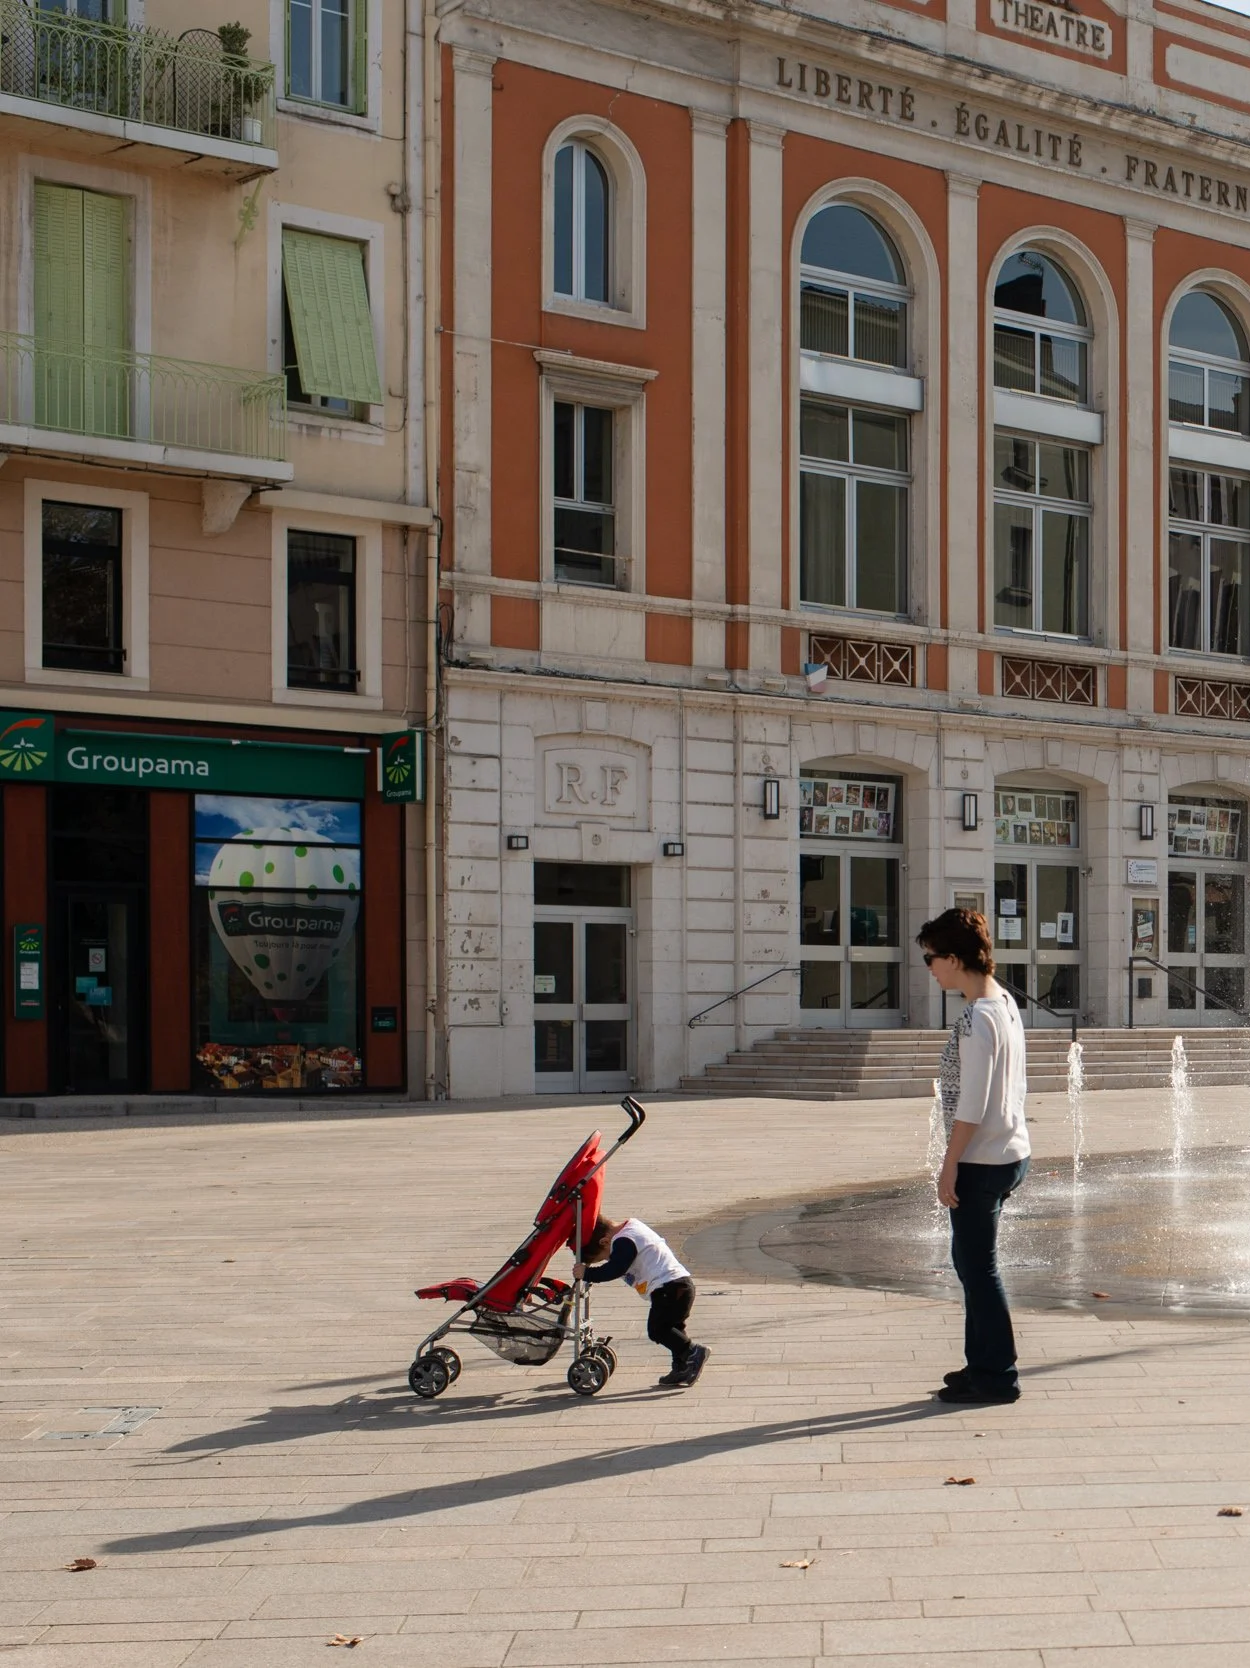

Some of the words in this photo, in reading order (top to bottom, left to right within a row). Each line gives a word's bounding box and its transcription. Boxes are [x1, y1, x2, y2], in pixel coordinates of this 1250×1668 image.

[998, 0, 1105, 52] THEATRE
[777, 57, 915, 121] LIBERTÉ
[955, 102, 1082, 167] ÉGALITÉ
[67, 746, 210, 778] Groupama
[386, 789, 412, 798] Groupama
[248, 911, 341, 932] Groupama
